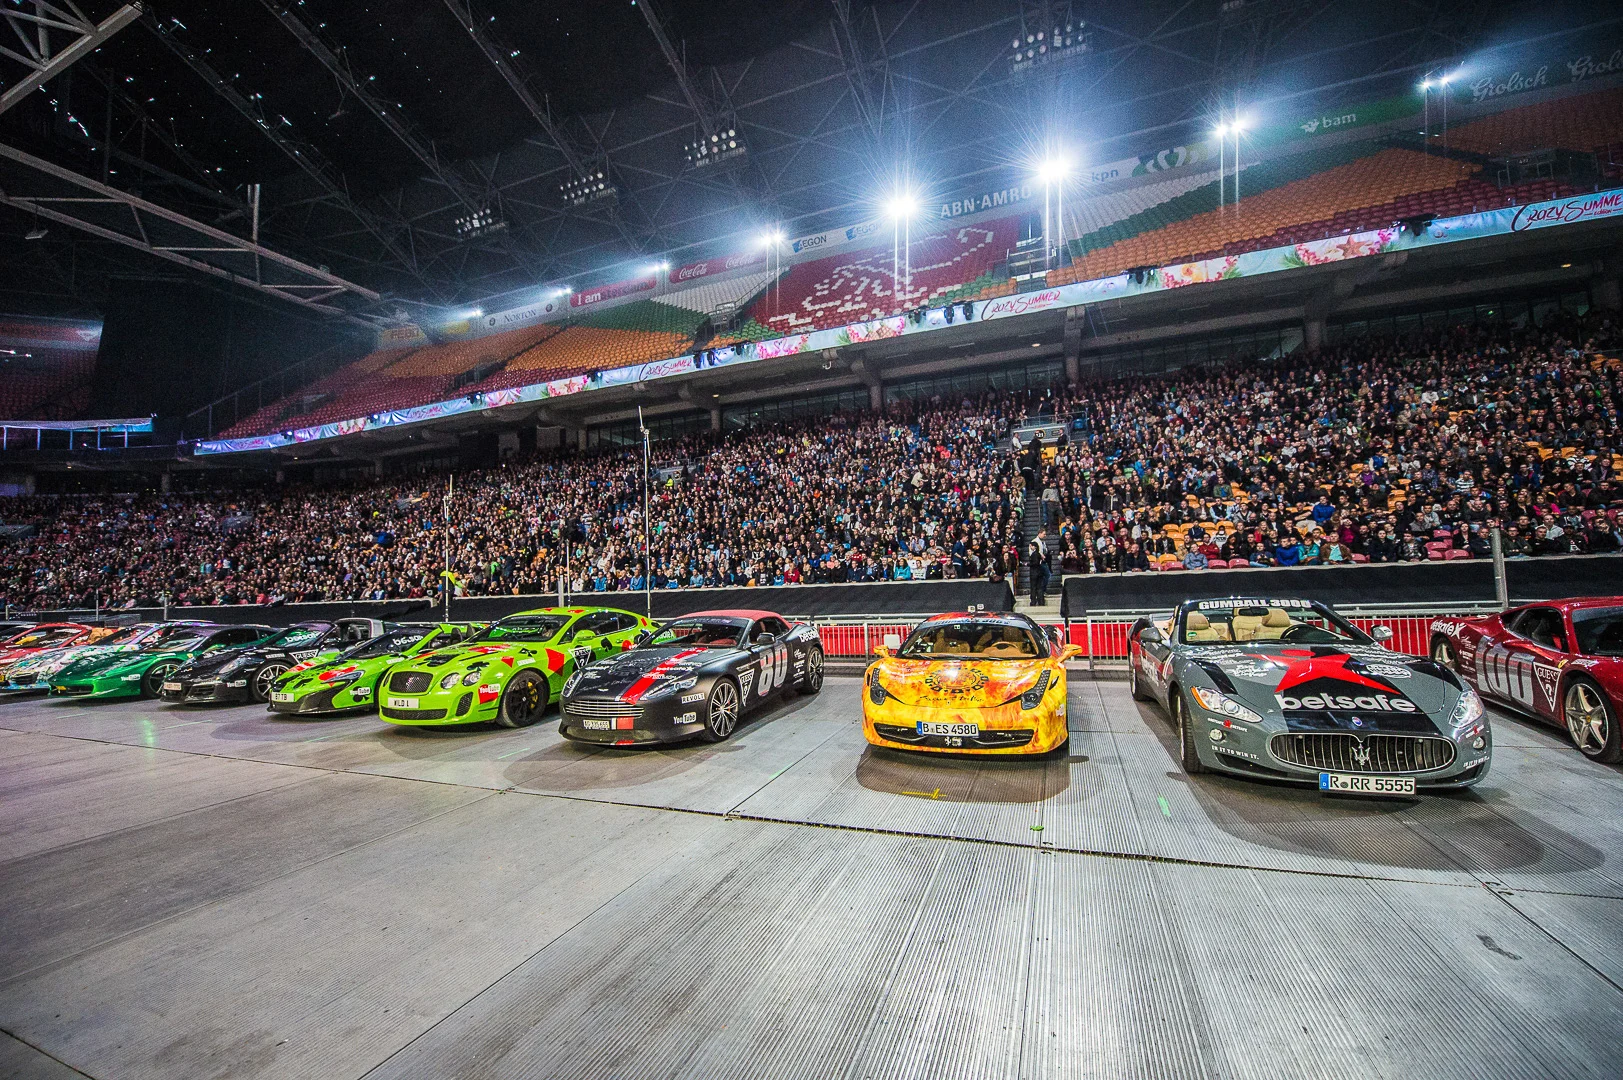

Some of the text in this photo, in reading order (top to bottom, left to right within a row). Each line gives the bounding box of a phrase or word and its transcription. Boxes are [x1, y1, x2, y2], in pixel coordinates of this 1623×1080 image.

[1566, 50, 1623, 82] Grols
[1470, 65, 1548, 101] Grolsch
[1322, 114, 1356, 128] bam
[1092, 168, 1118, 183] kpn
[1564, 194, 1623, 222] SUMME
[503, 308, 537, 325] NORTON
[1198, 599, 1312, 610] GUMBALL 3000
[757, 640, 788, 696] 80
[1537, 667, 1559, 681] GUESS
[682, 693, 704, 703] REVOLT
[1274, 692, 1416, 712] betsafe
[673, 711, 697, 725] YouTube
[923, 723, 977, 735] B ES 4580
[1329, 775, 1340, 789] R
[1350, 777, 1371, 791] RR
[1374, 779, 1414, 792] 5555
